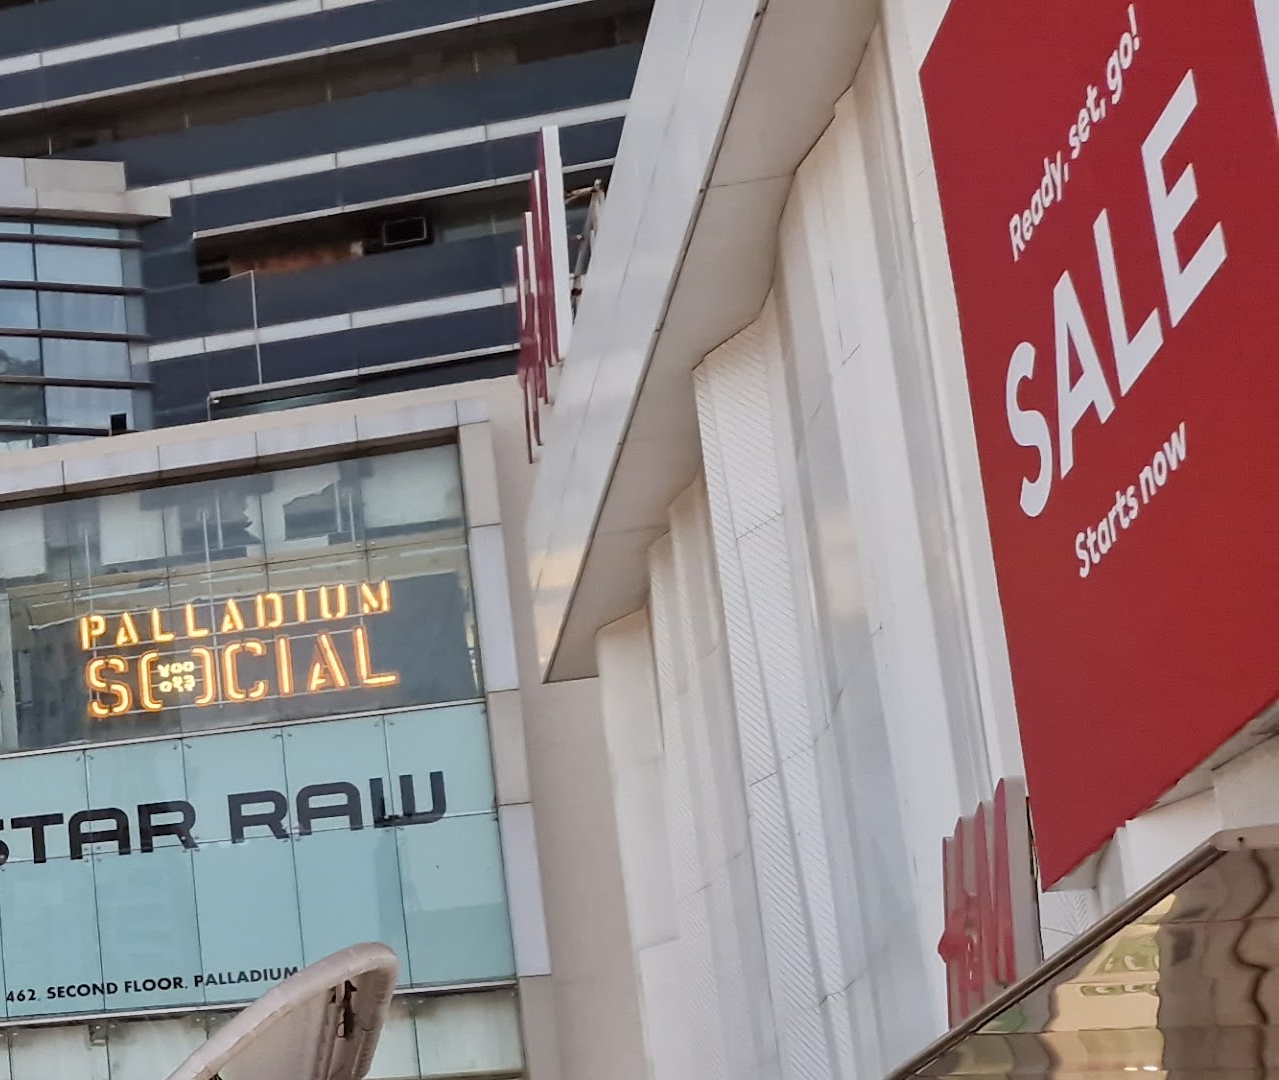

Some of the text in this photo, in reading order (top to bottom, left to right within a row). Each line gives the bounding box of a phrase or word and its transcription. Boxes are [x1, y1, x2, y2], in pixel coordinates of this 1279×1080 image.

[1009, 3, 1140, 262] Ready, set, go!
[1006, 68, 1227, 517] SALE
[1075, 421, 1186, 578] Starts now
[79, 579, 391, 650] PALLADIUM
[85, 626, 400, 717] SOCIAL
[228, 770, 446, 846] RAW
[46, 982, 118, 999] SECOND
[194, 966, 299, 988] PALLADIUM
